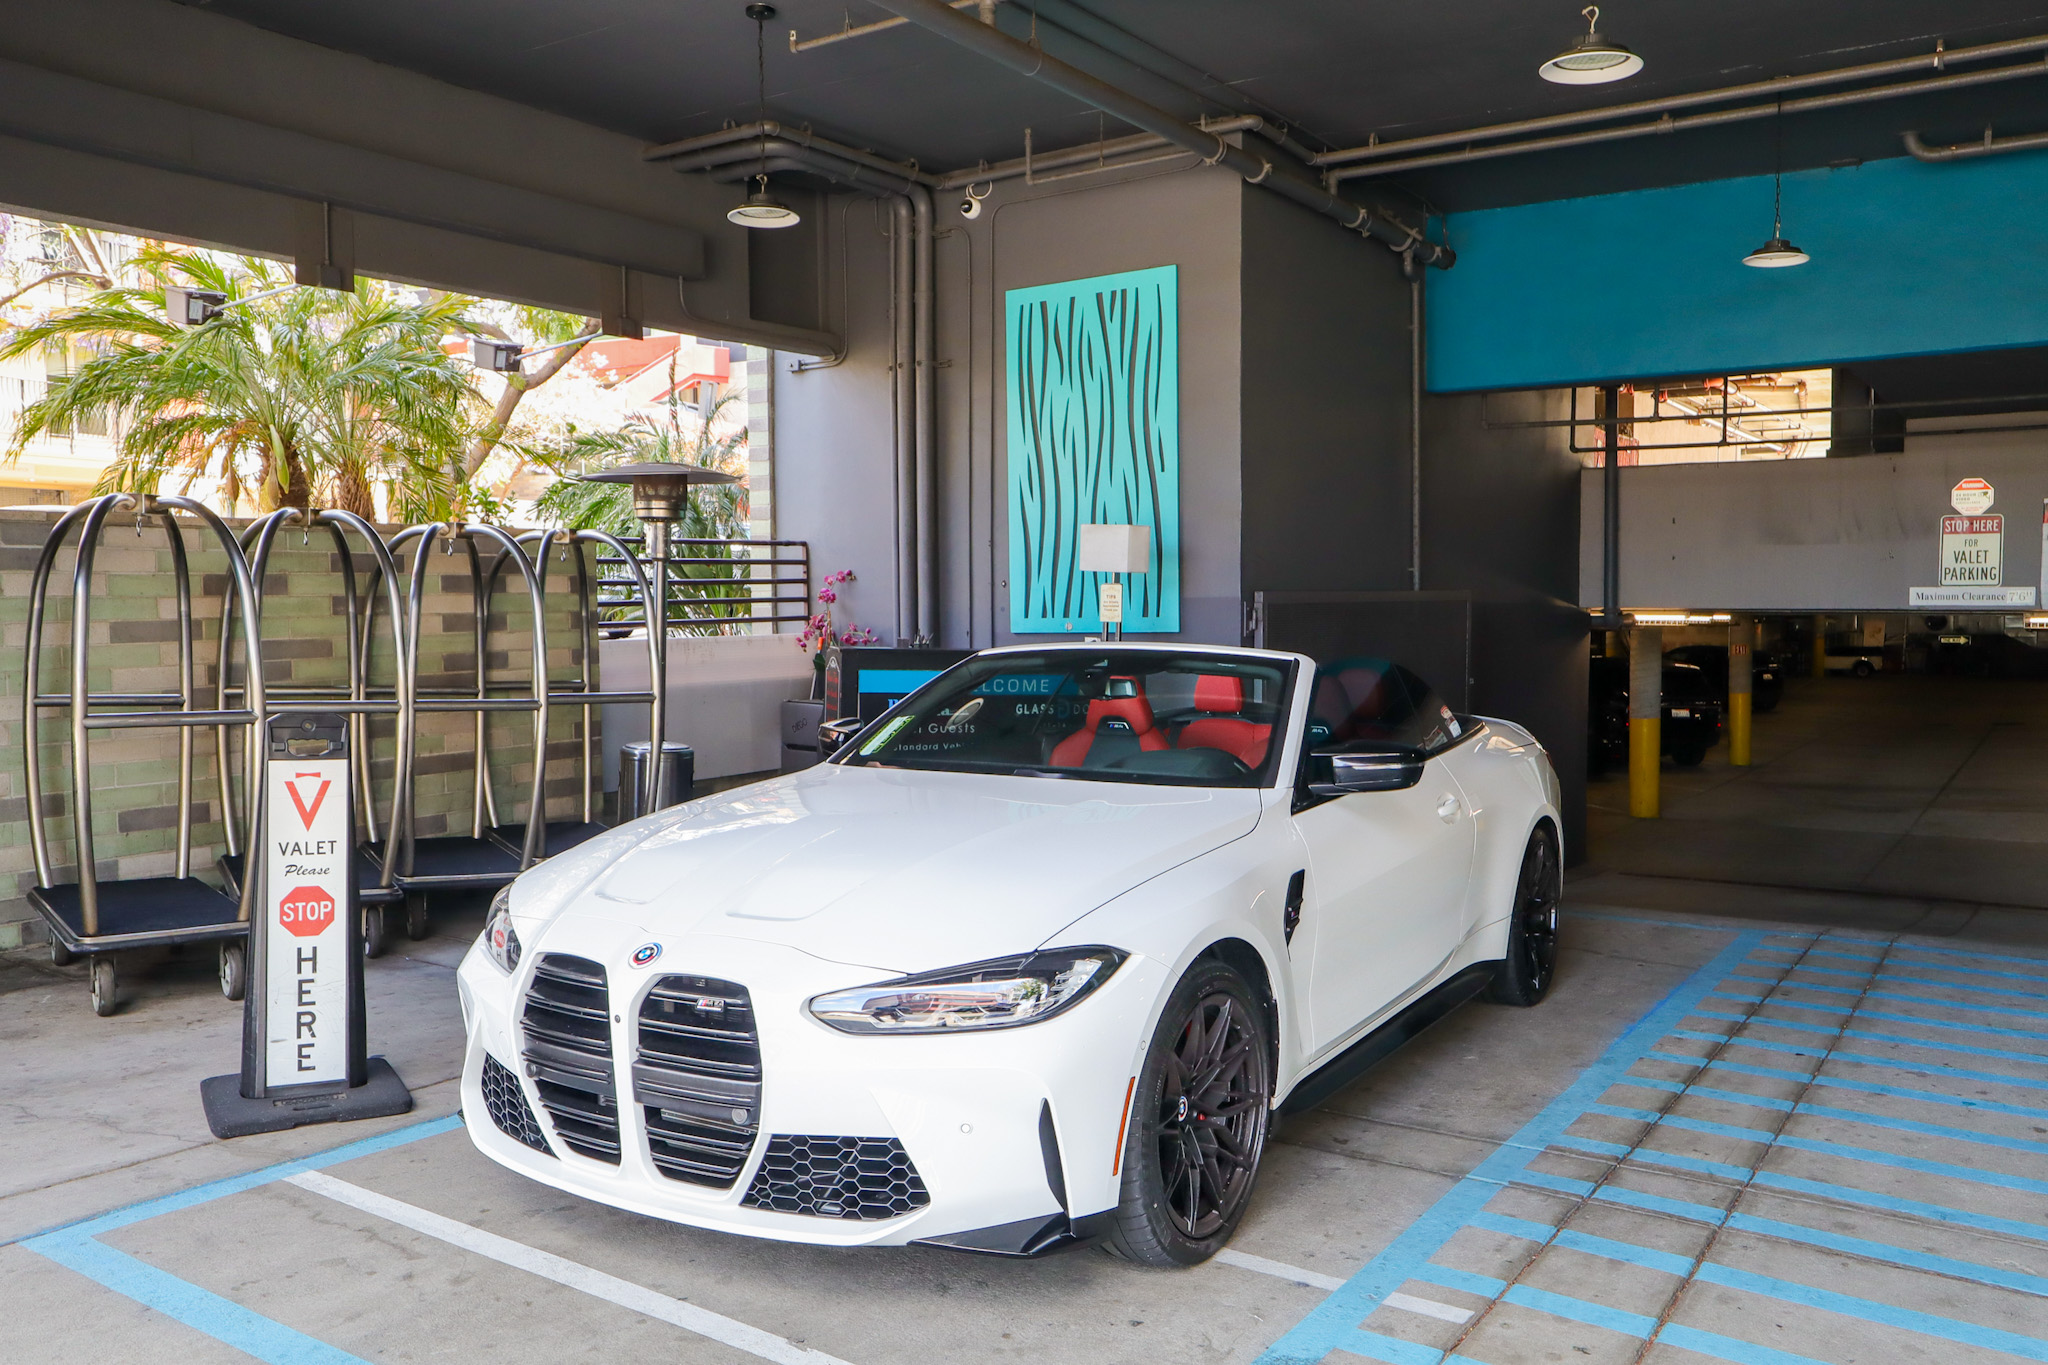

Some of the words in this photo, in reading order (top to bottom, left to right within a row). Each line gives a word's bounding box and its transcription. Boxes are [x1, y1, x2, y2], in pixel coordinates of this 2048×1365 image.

[1945, 520, 1970, 532] STOP
[1973, 519, 1999, 532] HERE
[1964, 539, 1979, 547] FOR
[1953, 549, 1989, 564] VALET
[1944, 566, 1997, 580] PARKING
[1915, 592, 1959, 600] Maximum
[1962, 592, 2006, 600] Clearance
[974, 679, 1049, 693] LCOME
[1016, 704, 1054, 715] GLASS
[928, 722, 976, 734] Guests
[278, 840, 337, 856] VALET
[284, 864, 331, 877] Please
[282, 900, 332, 922] STOP
[296, 946, 317, 1072] HERE
